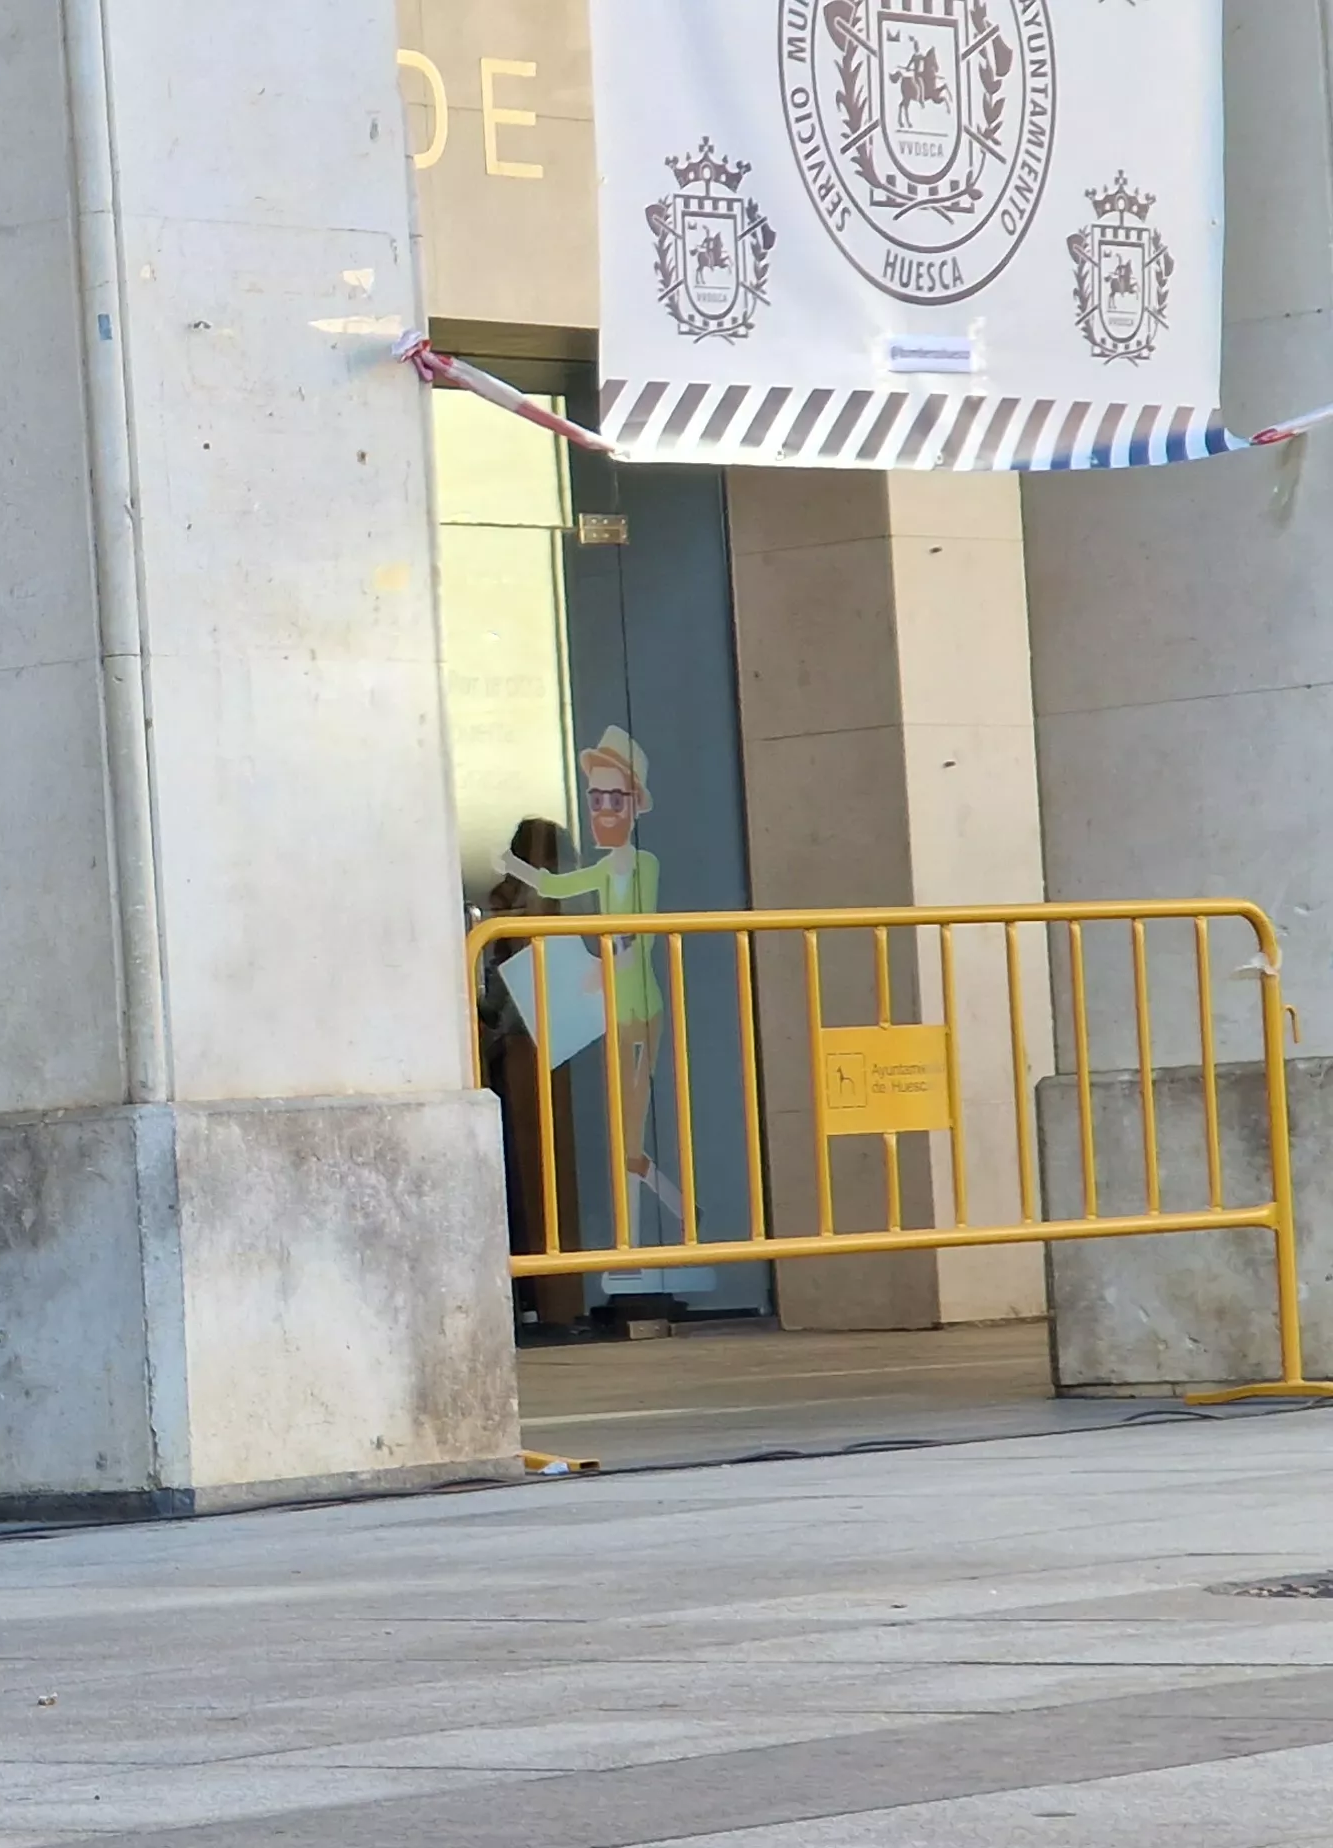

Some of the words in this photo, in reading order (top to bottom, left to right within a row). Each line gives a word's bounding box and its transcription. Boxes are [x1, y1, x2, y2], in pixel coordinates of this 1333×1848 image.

[396, 48, 544, 179] DE
[790, 86, 852, 232] SERVICIO
[1000, 0, 1049, 236] AYUNTAMIENTO
[882, 248, 965, 292] HUESCA
